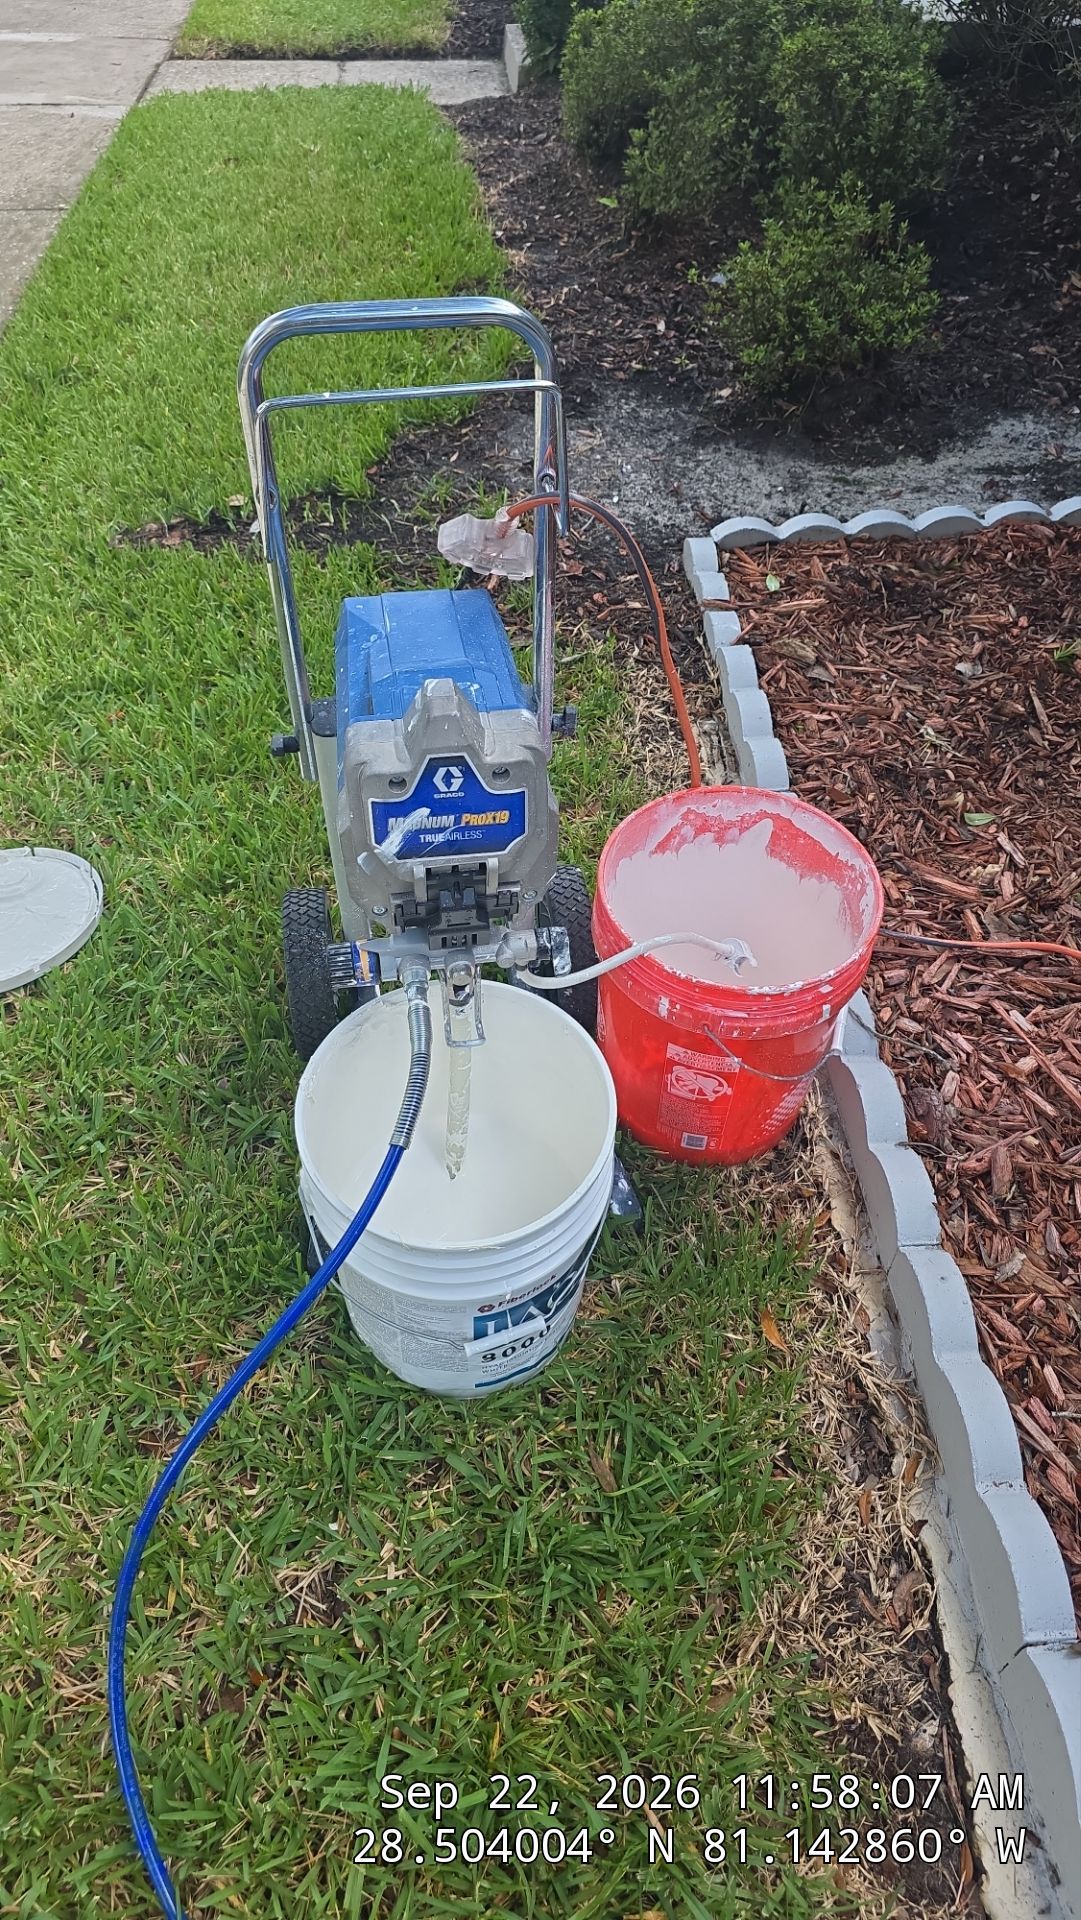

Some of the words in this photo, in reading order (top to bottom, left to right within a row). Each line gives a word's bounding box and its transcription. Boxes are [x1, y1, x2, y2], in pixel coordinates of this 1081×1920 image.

[433, 791, 465, 799] GRACO
[419, 829, 483, 843] TRUEAIRLESS
[690, 1051, 726, 1062] WARNING
